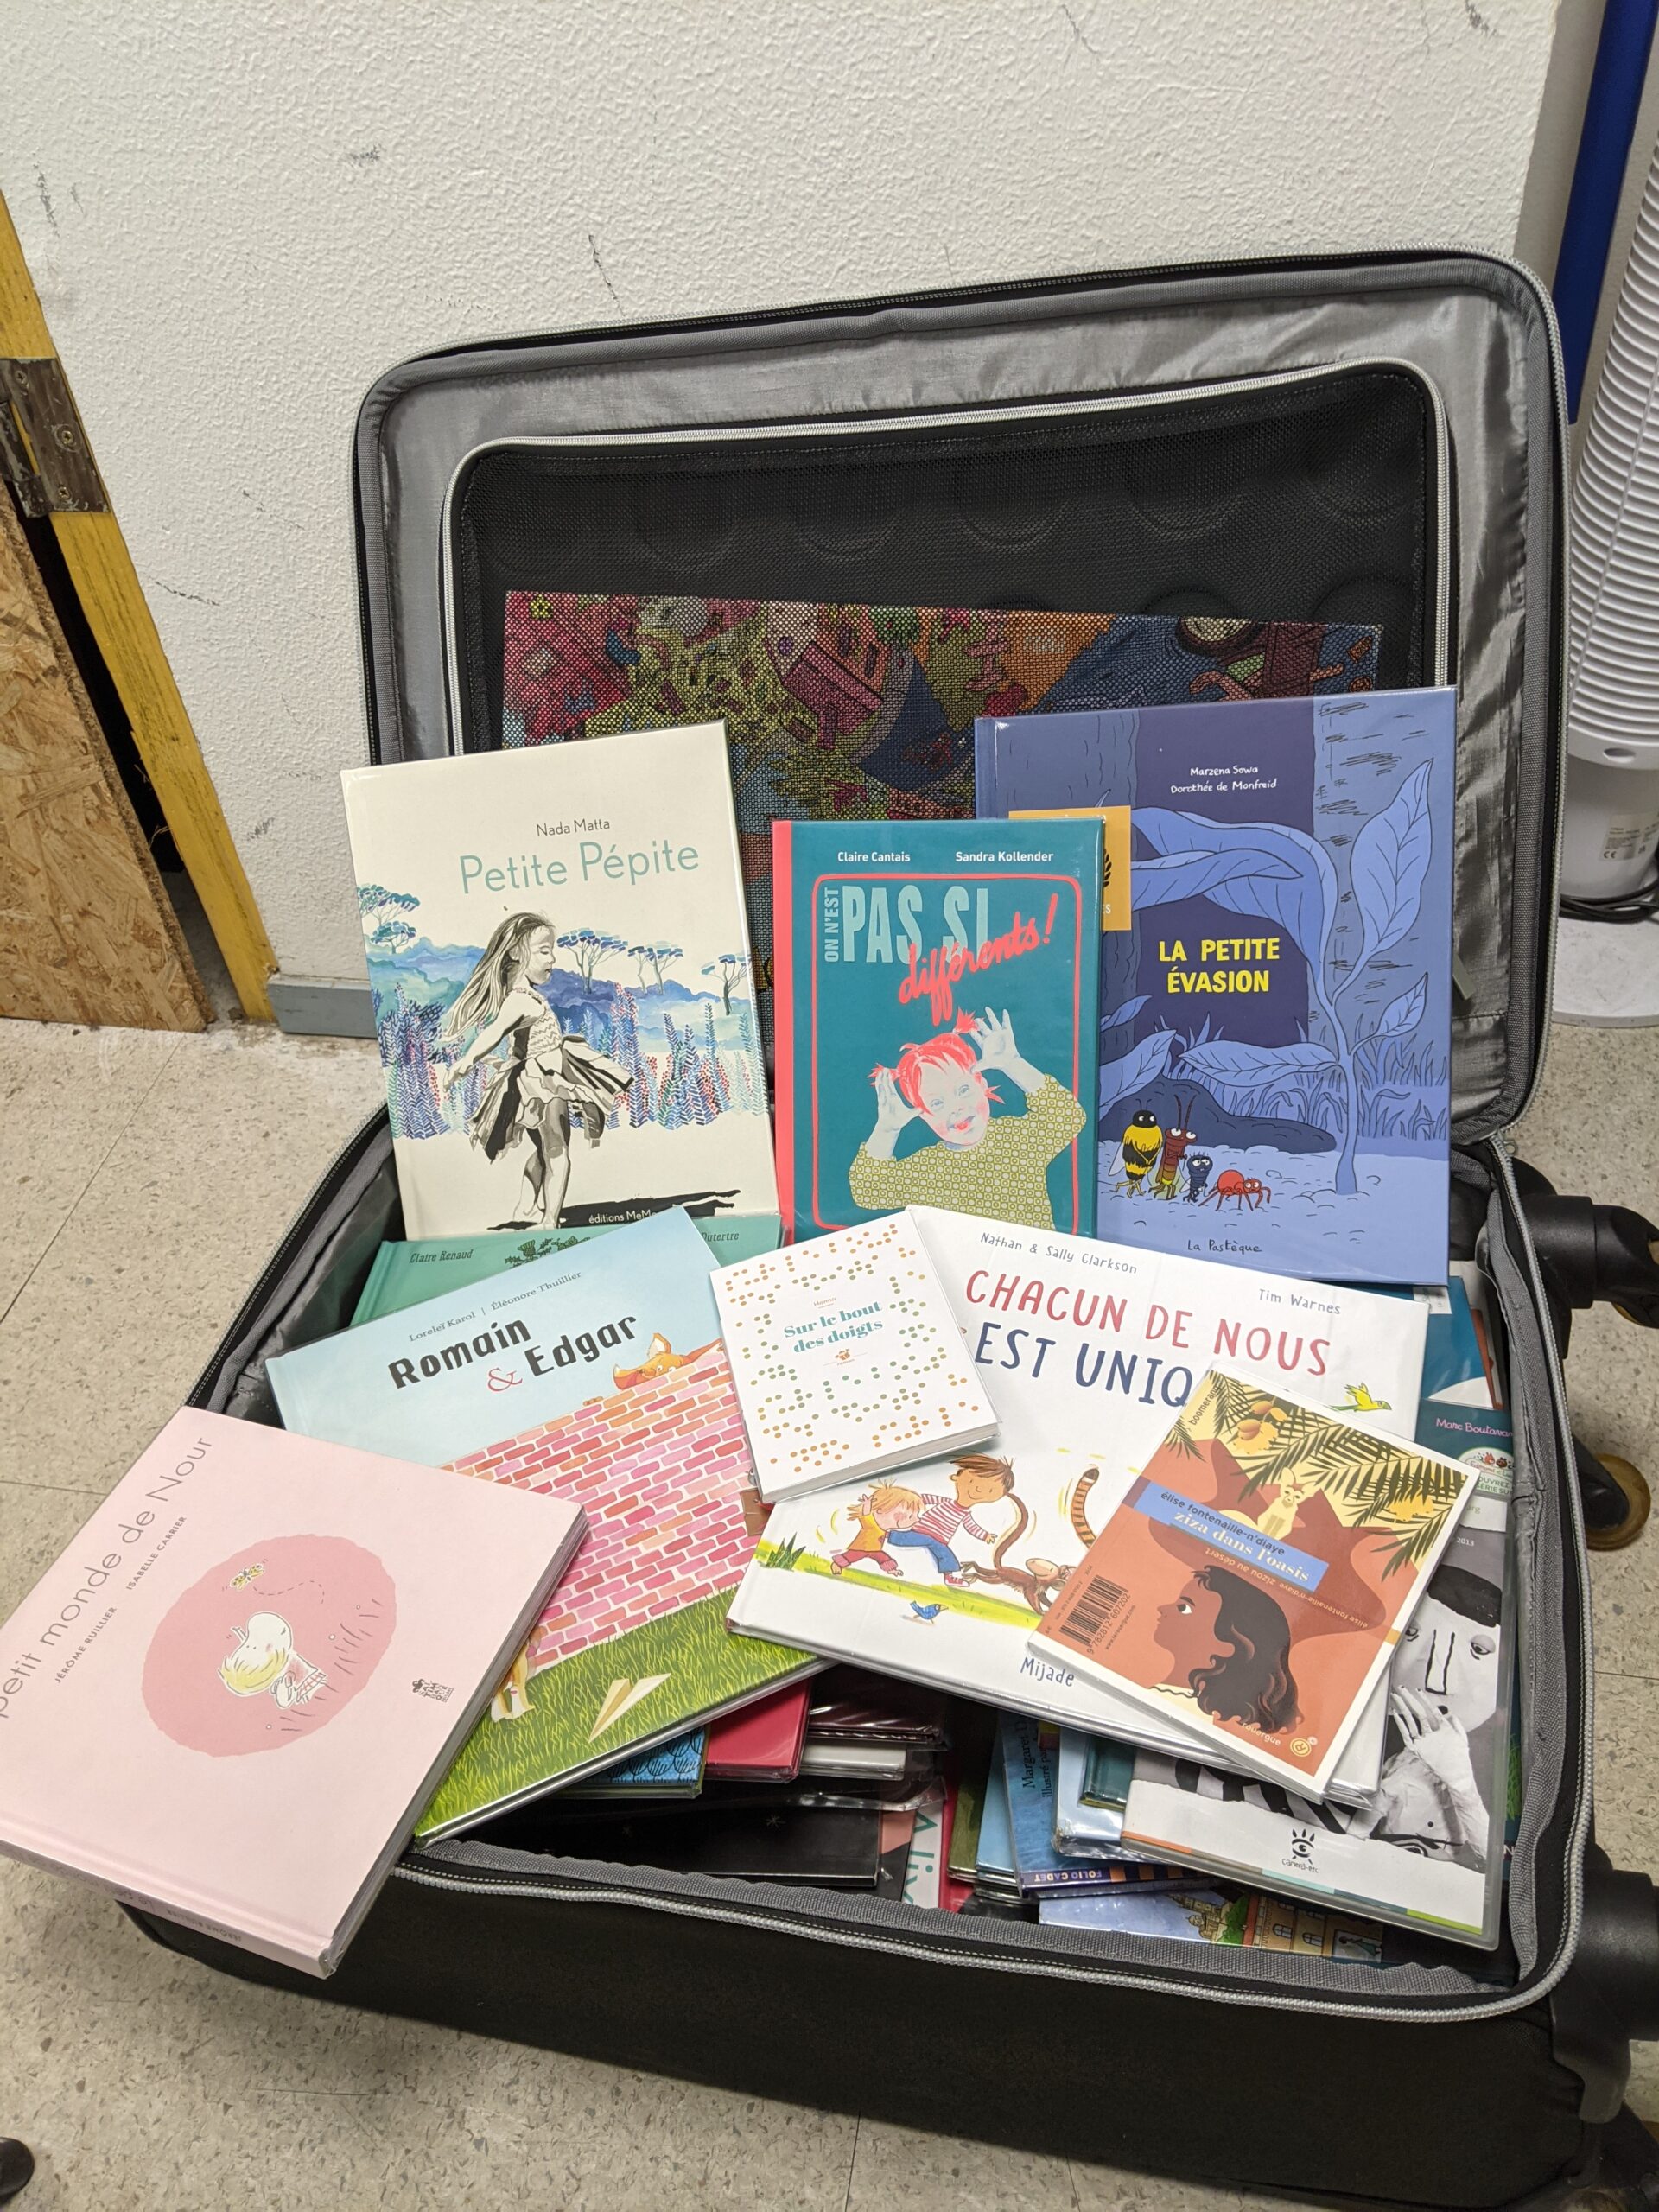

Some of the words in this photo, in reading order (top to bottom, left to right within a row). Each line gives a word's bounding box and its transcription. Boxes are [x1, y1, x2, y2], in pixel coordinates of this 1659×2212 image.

[1190, 766, 1230, 777] Marzena
[1233, 766, 1258, 775] Sowa
[1171, 780, 1213, 794] Dorothée
[1217, 782, 1228, 791] de
[1232, 779, 1277, 791] Monfreid
[536, 822, 570, 836] Nada
[574, 818, 611, 833] Matta
[460, 855, 568, 894] Petite
[579, 839, 699, 886] Pépite
[837, 852, 868, 862] Claire
[871, 852, 911, 862] Cantais
[955, 852, 995, 862] Sandra
[998, 851, 1054, 862] Kollender
[824, 887, 840, 931] N'EST
[842, 885, 923, 964] PAS
[943, 886, 988, 963] SI
[824, 933, 840, 963] ON
[899, 893, 1058, 1027] différents!
[1159, 940, 1187, 962] LA
[1201, 938, 1280, 961] PETITE
[1167, 966, 1269, 993] ÉVASION
[588, 1214, 625, 1224] éditions
[410, 1251, 436, 1263] Claire
[439, 1249, 474, 1261] Renaud
[981, 1232, 1022, 1251] Nathan
[1030, 1243, 1038, 1254] &
[1046, 1246, 1075, 1262] Sally
[1081, 1253, 1137, 1274] Clarkson
[1187, 1239, 1200, 1251] La
[1209, 1238, 1263, 1254] Pastèque
[409, 1324, 446, 1342] Loreleï
[447, 1311, 476, 1328] Karol
[490, 1288, 537, 1311] Éléonore
[537, 1272, 582, 1292] Thuillier
[1259, 1289, 1281, 1304] Tim
[1290, 1294, 1341, 1315] Warnes
[784, 1322, 817, 1338] Sur
[819, 1316, 837, 1327] le
[839, 1301, 882, 1322] bout
[966, 1270, 1128, 1332] CHACUN
[1145, 1305, 1193, 1349] DE
[1213, 1319, 1331, 1376] NOUS
[793, 1338, 824, 1352] des
[827, 1320, 883, 1343] doigts
[388, 1319, 531, 1389] Romain
[487, 1367, 523, 1392] &
[524, 1316, 637, 1376] Edgar
[975, 1321, 1056, 1378] EST
[1074, 1342, 1194, 1408] UNIQ
[1436, 1418, 1463, 1431] Marc
[1465, 1422, 1512, 1438] Boutavan
[1478, 1477, 1510, 1488] OUVREZ
[1160, 1491, 1185, 1508] élise
[40, 1553, 122, 1646] monde
[118, 1510, 156, 1544] de
[145, 1437, 213, 1503] Nour
[1173, 1511, 1208, 1535] ziza
[1212, 1529, 1254, 1555] dans
[1256, 1548, 1311, 1582] l'oasis
[1456, 1537, 1475, 1546] 2013
[1205, 1548, 1236, 1567] désert
[1237, 1562, 1250, 1573] au
[1251, 1568, 1276, 1585] zizou
[54, 1645, 86, 1684] JÉRÔME
[84, 1605, 118, 1645] RUILLIER
[125, 1552, 158, 1590] ISABELLE
[156, 1516, 188, 1552] CARRIER
[1020, 1656, 1075, 1687] Mijade
[1242, 1722, 1281, 1746] rouergue
[1021, 1733, 1035, 1789] Margaret
[1041, 1764, 1053, 1798] illustré
[1034, 1871, 1069, 1882] CADET
[1071, 1869, 1103, 1879] FOLIO
